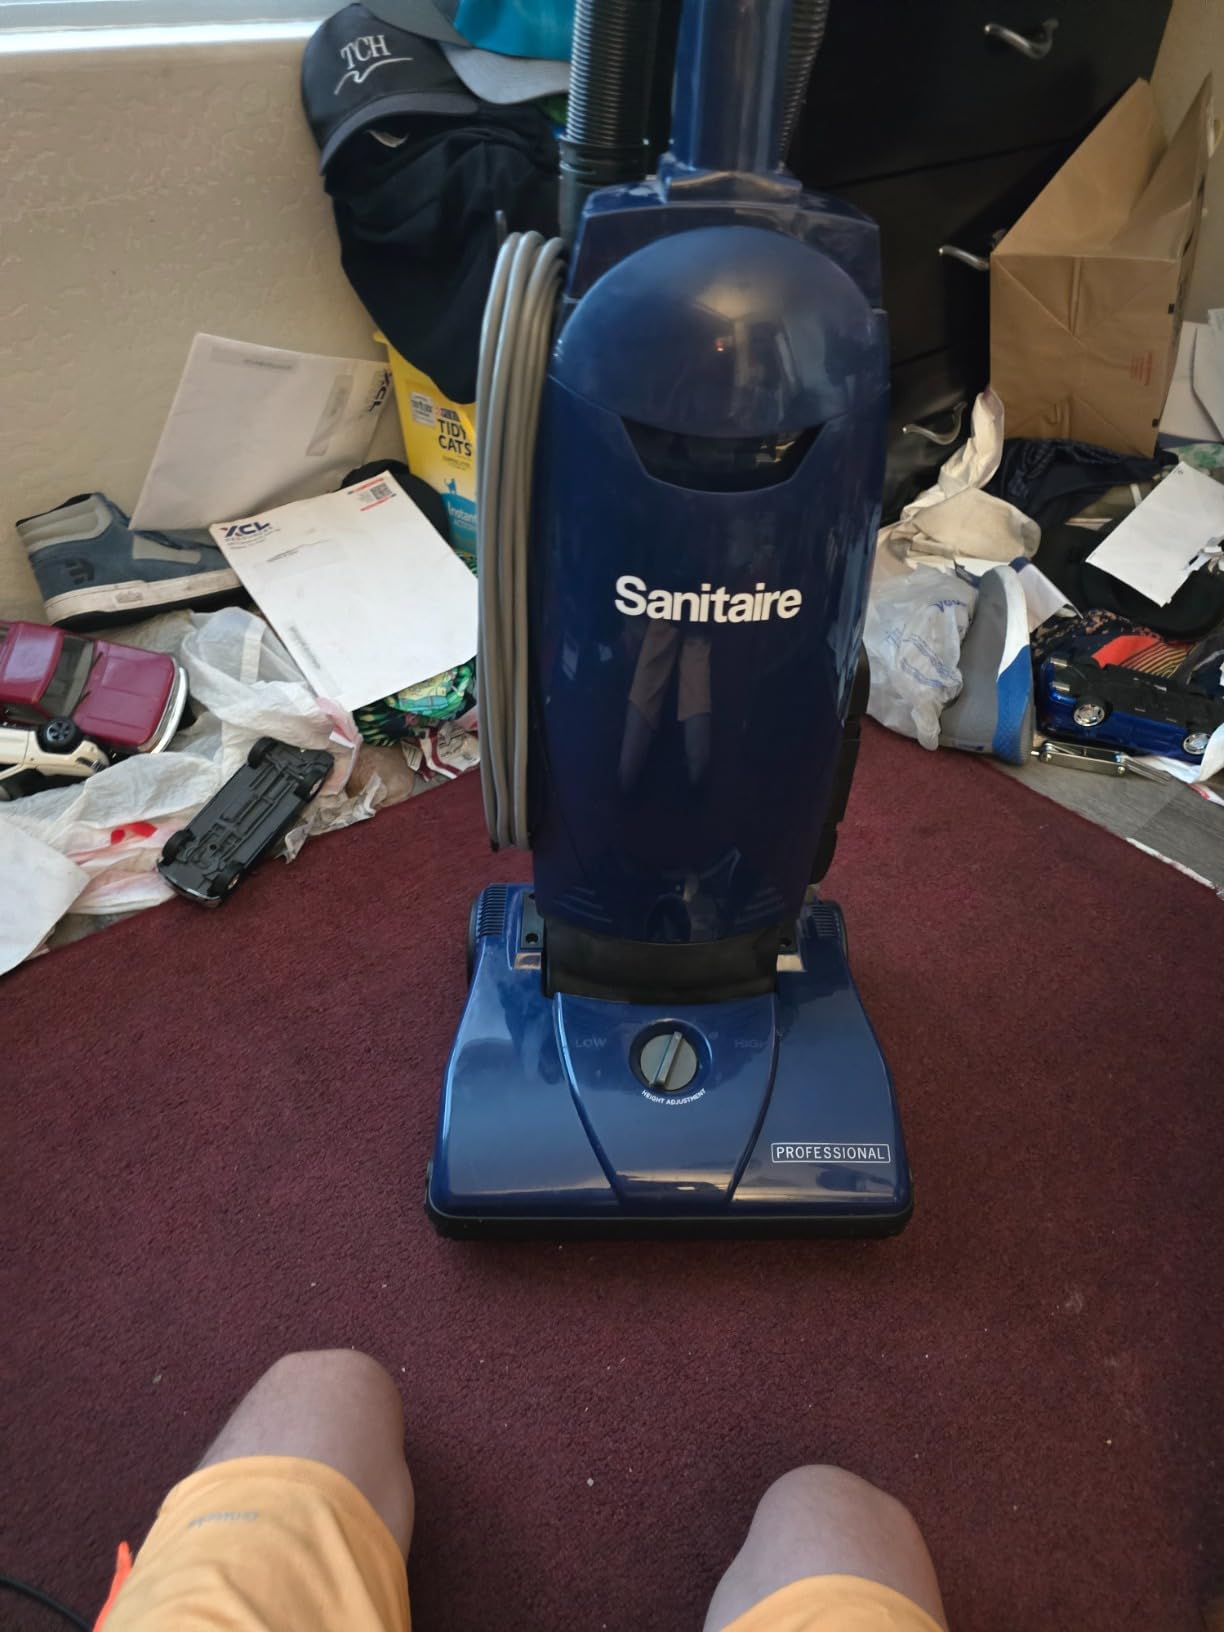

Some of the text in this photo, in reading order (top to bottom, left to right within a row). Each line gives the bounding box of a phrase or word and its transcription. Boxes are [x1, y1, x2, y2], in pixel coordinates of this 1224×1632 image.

[340, 34, 392, 70] TCH
[438, 418, 467, 440] TIDY
[438, 434, 472, 457] CATS
[219, 521, 271, 538] XCL
[614, 575, 803, 623] Sanitaire
[575, 1038, 608, 1049] LOW
[641, 1087, 707, 1106] HEIGHT ADJUSTMENT
[776, 1146, 886, 1160] PROFESSIONAL
